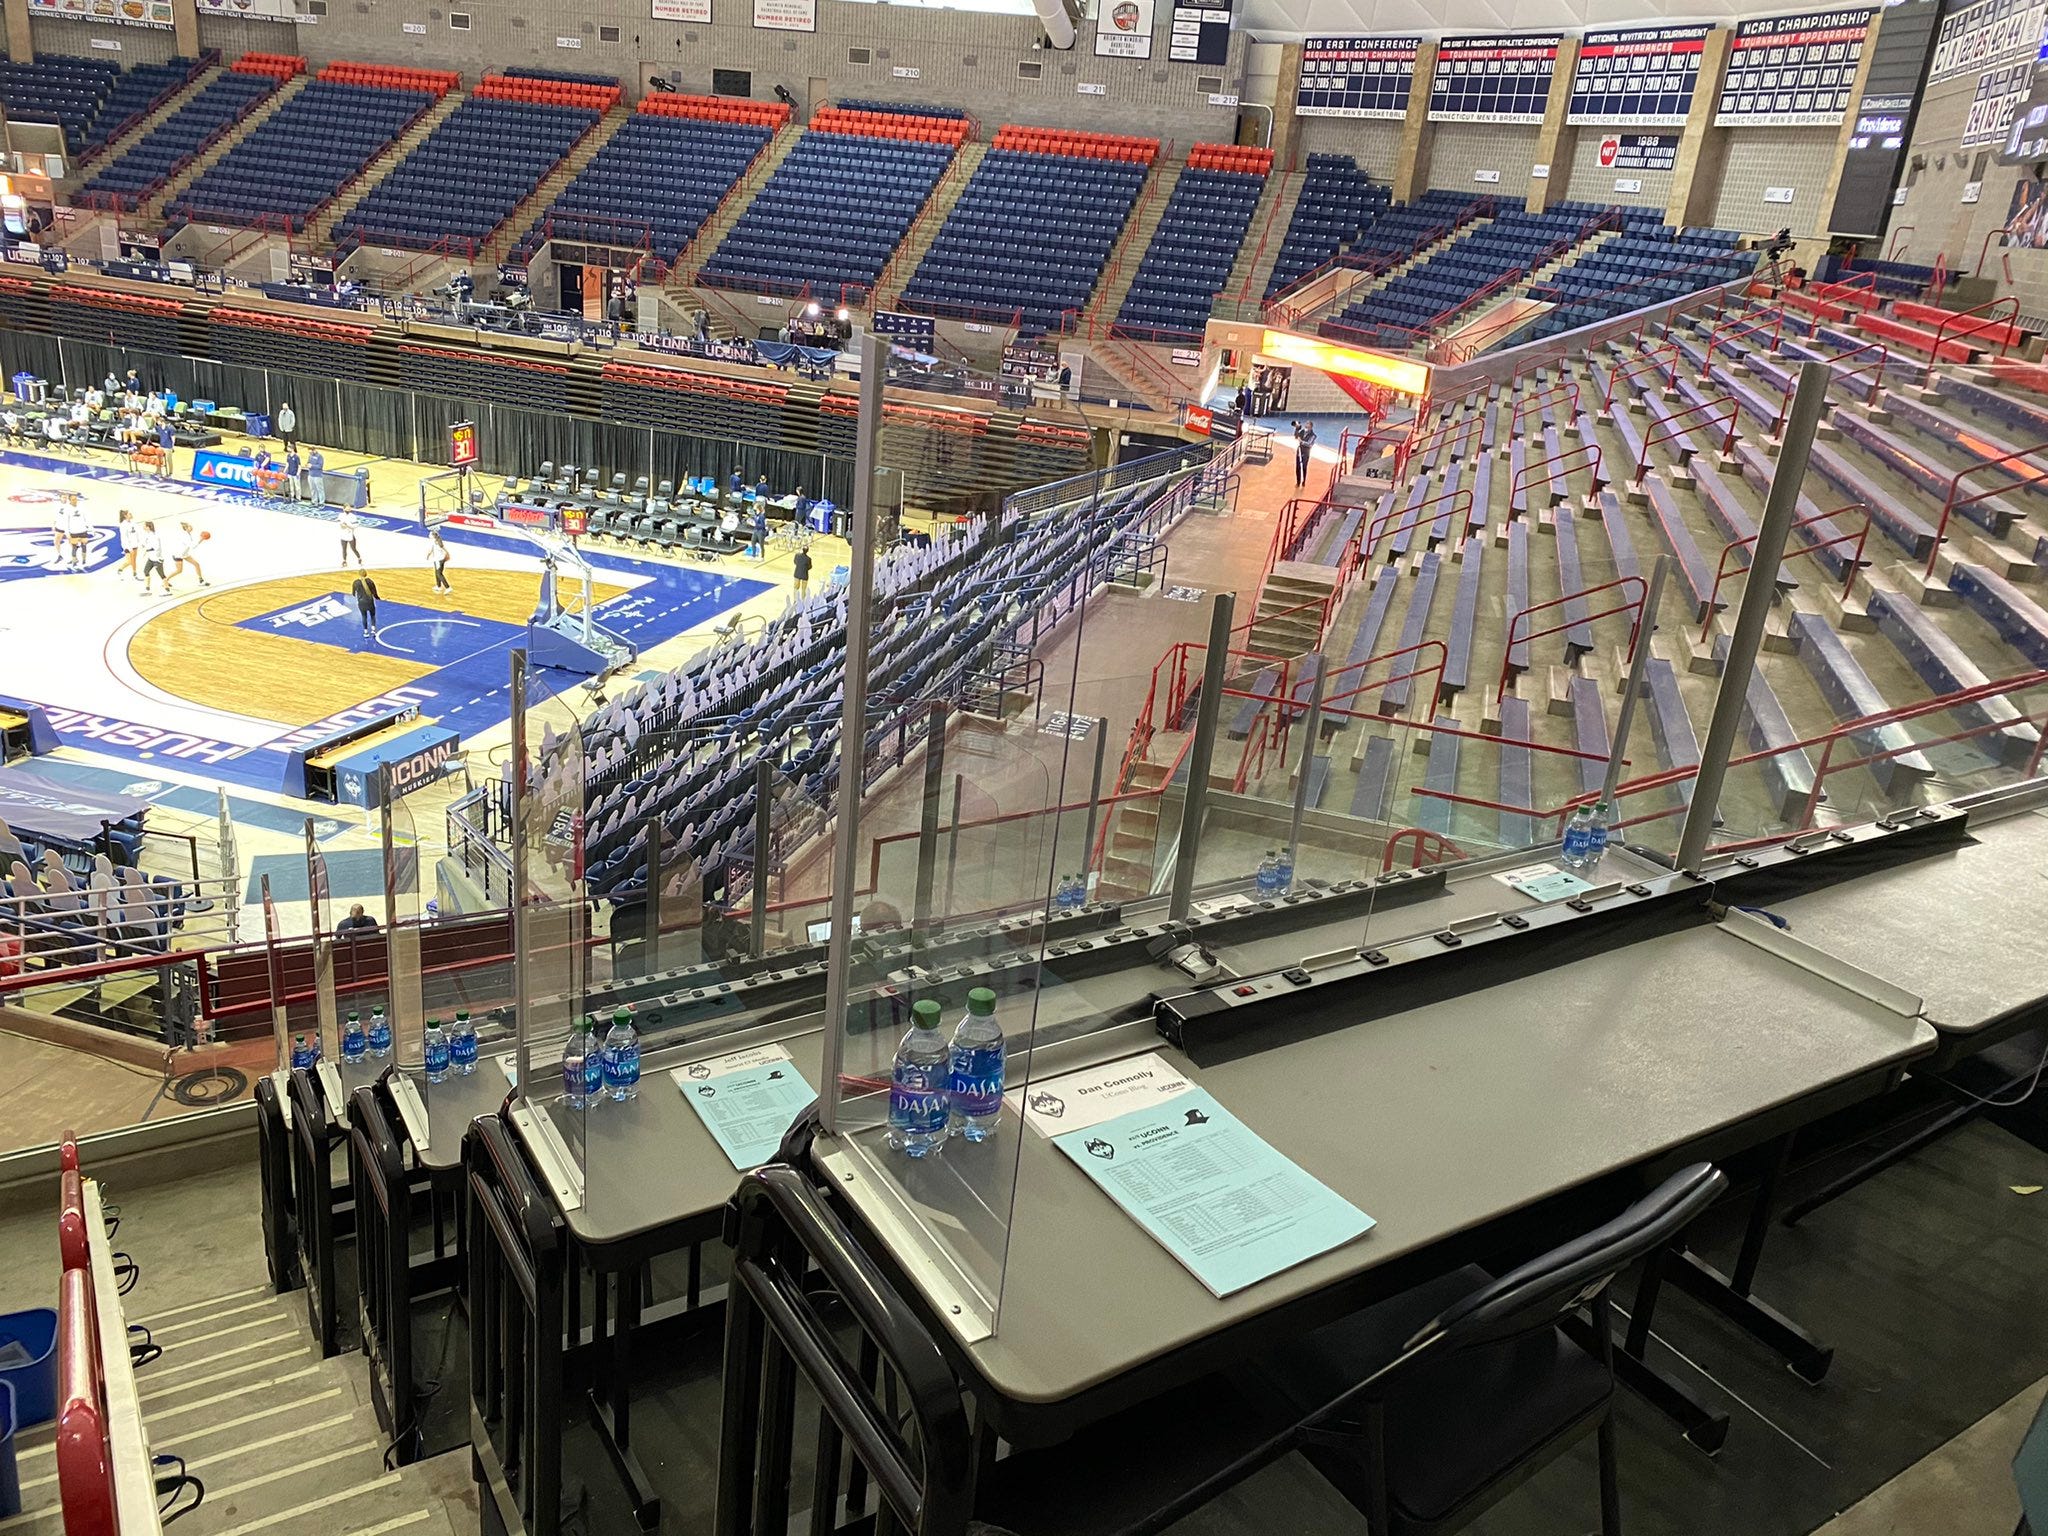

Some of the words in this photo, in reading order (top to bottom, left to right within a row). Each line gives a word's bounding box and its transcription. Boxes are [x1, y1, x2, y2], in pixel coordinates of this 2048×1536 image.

[655, 5, 681, 13] NUMBER
[682, 7, 708, 15] RETIRED
[29, 10, 82, 20] CONNECTICUT
[86, 16, 122, 25] WOMEN'S
[124, 20, 173, 31] BASKETBALL
[757, 14, 783, 22] NUMBER
[785, 16, 812, 24] RETIRED
[1743, 22, 1772, 34] NCAA
[1777, 11, 1870, 32] CHAMPIONSHIP
[1588, 34, 1619, 43] NATIONAL
[1620, 31, 1658, 41] INVITATION
[1659, 28, 1708, 39] TOURNAMENT
[1740, 34, 1796, 48] TOURNAMENT
[1799, 28, 1867, 43] APPEARANCES
[1306, 40, 1321, 49] BIG
[1326, 40, 1350, 49] EAST
[1354, 39, 1418, 49] CONFERENCE
[1613, 42, 1674, 54] APPEARANCES
[1372, 50, 1416, 58] CHAMPIONS
[1449, 49, 1499, 58] TOURNAMENT
[1501, 49, 1548, 58] CHAMPIONS
[1093, 85, 1105, 93] 211
[1223, 96, 1237, 105] 212
[1298, 107, 1340, 115] CONNECTICUT
[1342, 108, 1361, 116] MEN'S
[1364, 109, 1405, 118] BASKETBALL
[1431, 112, 1474, 120] CONNECTICUT
[1476, 113, 1497, 121] MEN'S
[1499, 114, 1543, 122] BASKETBALL
[1719, 116, 1767, 124] CONNECTICUT
[1770, 115, 1792, 123] MEN'S
[1795, 114, 1841, 123] BASKETBAL
[1857, 117, 1902, 132] Providence
[1637, 136, 1659, 147] 1988
[1491, 172, 1497, 180] 4
[1633, 182, 1638, 190] 5
[1784, 190, 1790, 200] 6
[505, 273, 527, 282] CLUB
[413, 306, 427, 315] 109
[553, 323, 568, 333] 109
[643, 333, 691, 351] UCONN
[705, 344, 753, 362] UCONN
[1187, 350, 1201, 359] 212
[980, 382, 993, 391] 111
[1015, 386, 1027, 395] 111
[1188, 411, 1211, 429] Coca-Cola
[38, 705, 244, 765] HUSKIE
[402, 775, 435, 794] HUSKIES
[1077, 1085, 1103, 1096] Dan
[1103, 1070, 1154, 1088] Connolly
[1157, 1081, 1186, 1092] UCONN
[1100, 1088, 1129, 1099] UConn
[1128, 1084, 1148, 1094] Blog
[1140, 1125, 1170, 1138] UCONN
[1141, 1130, 1180, 1146] PROVIDENCE
